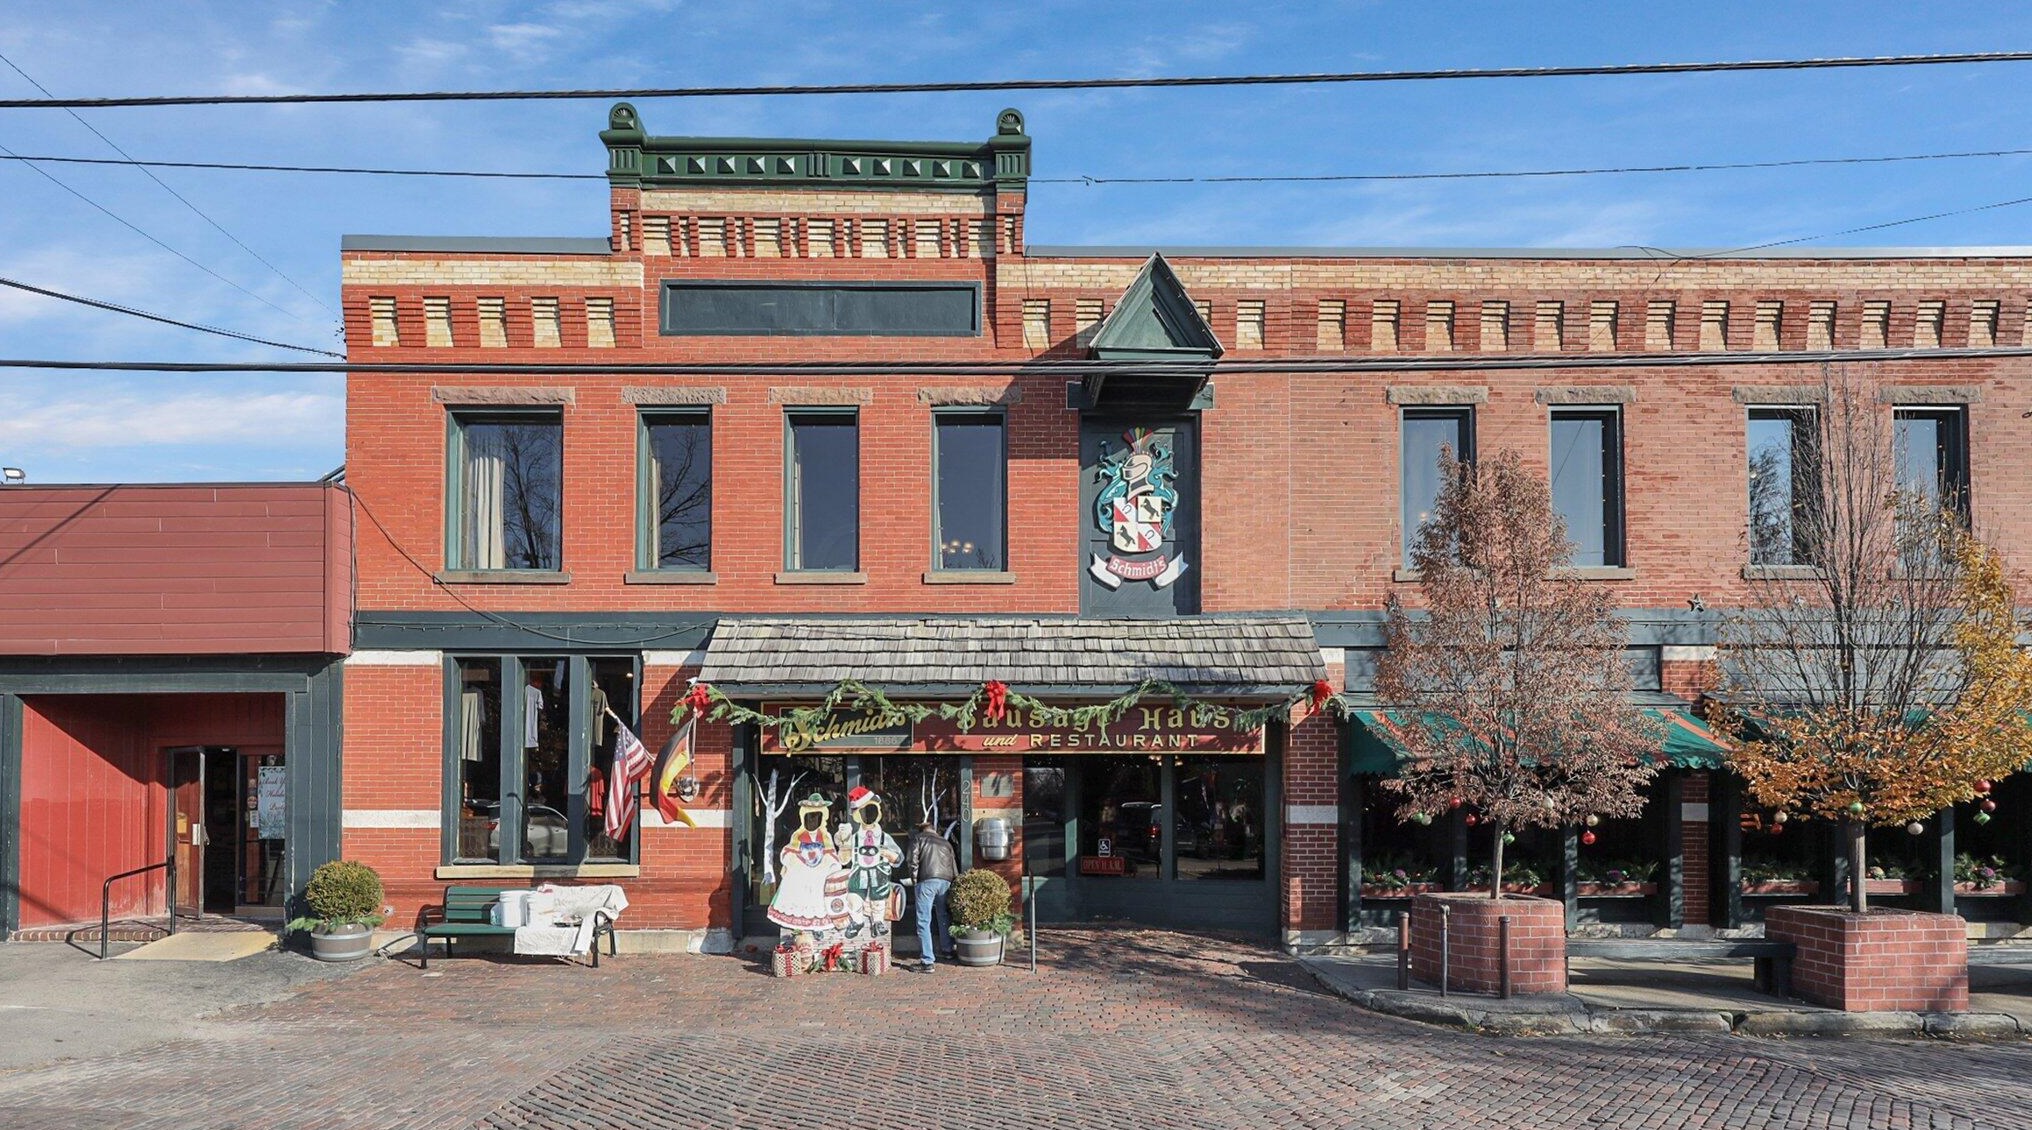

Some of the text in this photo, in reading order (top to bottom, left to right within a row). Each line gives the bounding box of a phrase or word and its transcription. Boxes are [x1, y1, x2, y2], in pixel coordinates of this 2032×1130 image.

[1109, 558, 1167, 577] Schmidt's
[956, 707, 1111, 733] Sausag
[983, 733, 1199, 748] und RESTAURANT
[962, 780, 971, 823] 240
